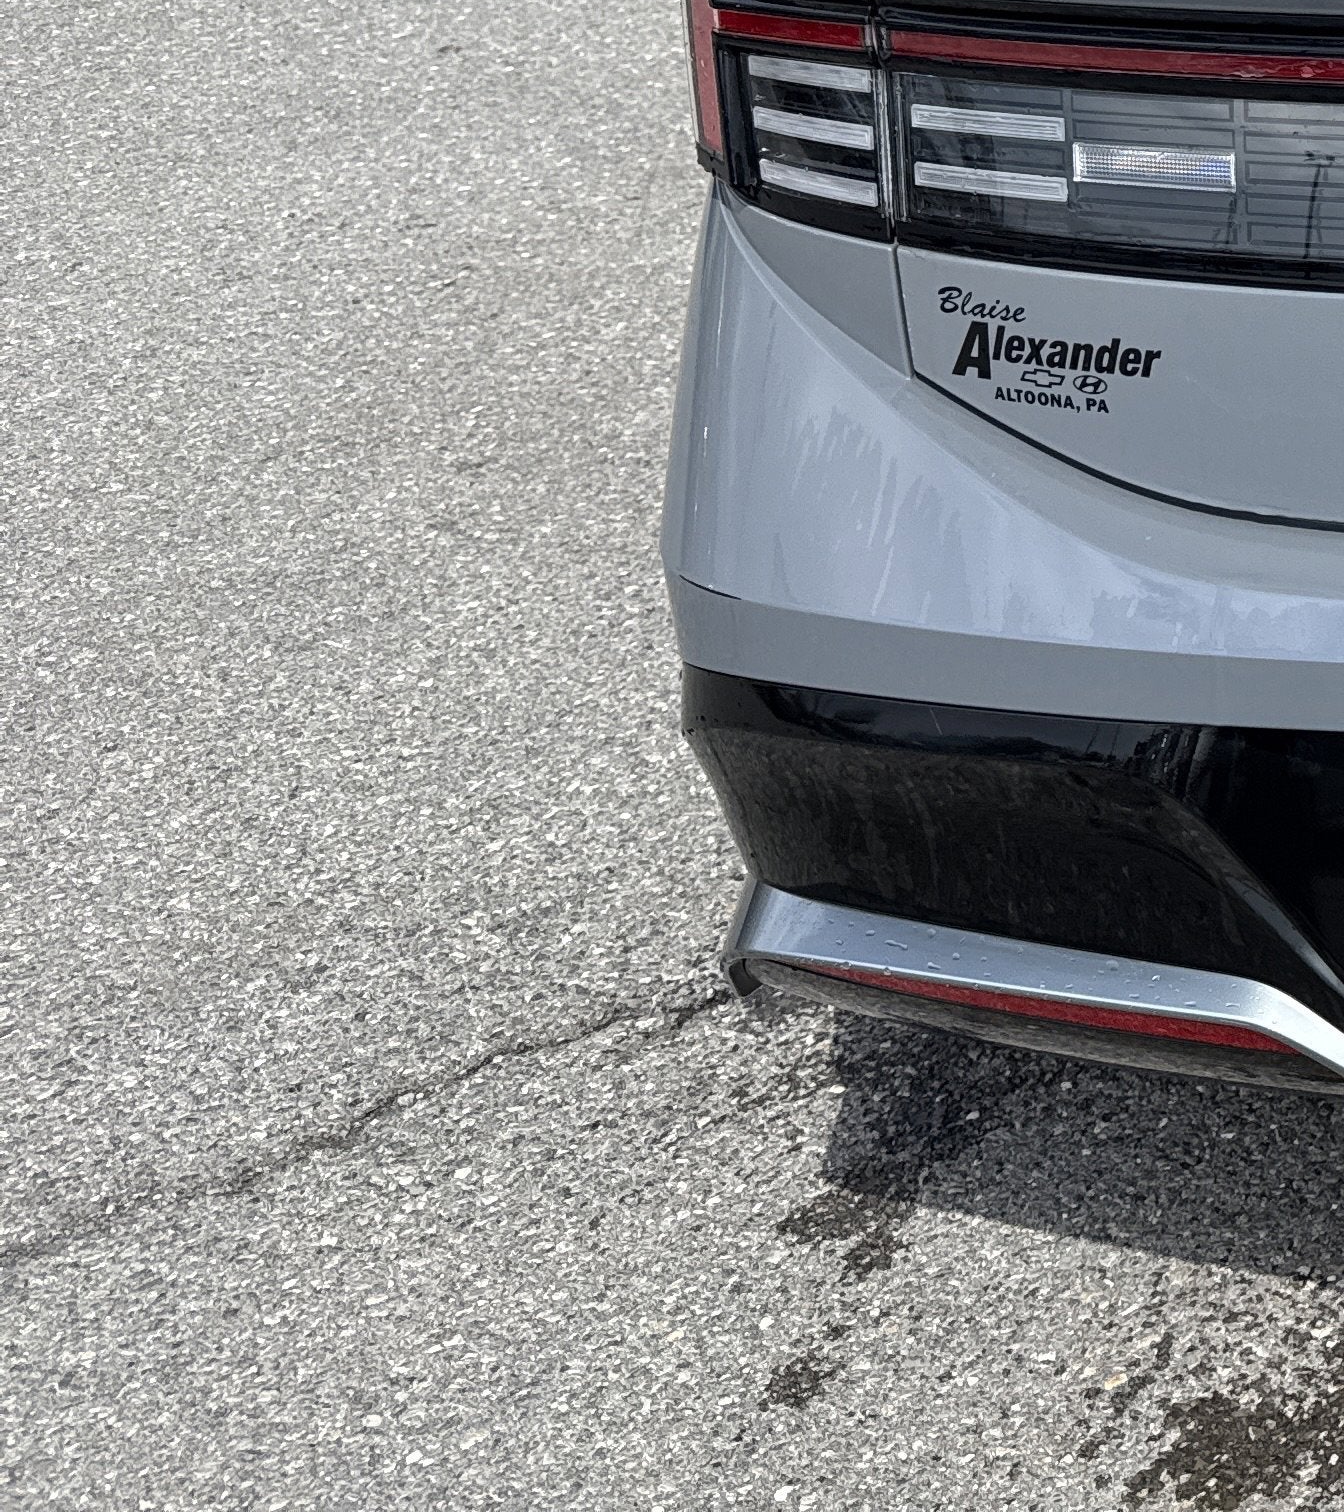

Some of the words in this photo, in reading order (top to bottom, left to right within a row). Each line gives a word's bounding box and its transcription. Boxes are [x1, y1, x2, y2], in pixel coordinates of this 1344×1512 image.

[938, 285, 1027, 323] Blaise
[952, 321, 1162, 380] Alexander
[994, 386, 1081, 414] ALTOONA,
[1085, 397, 1110, 414] PA
